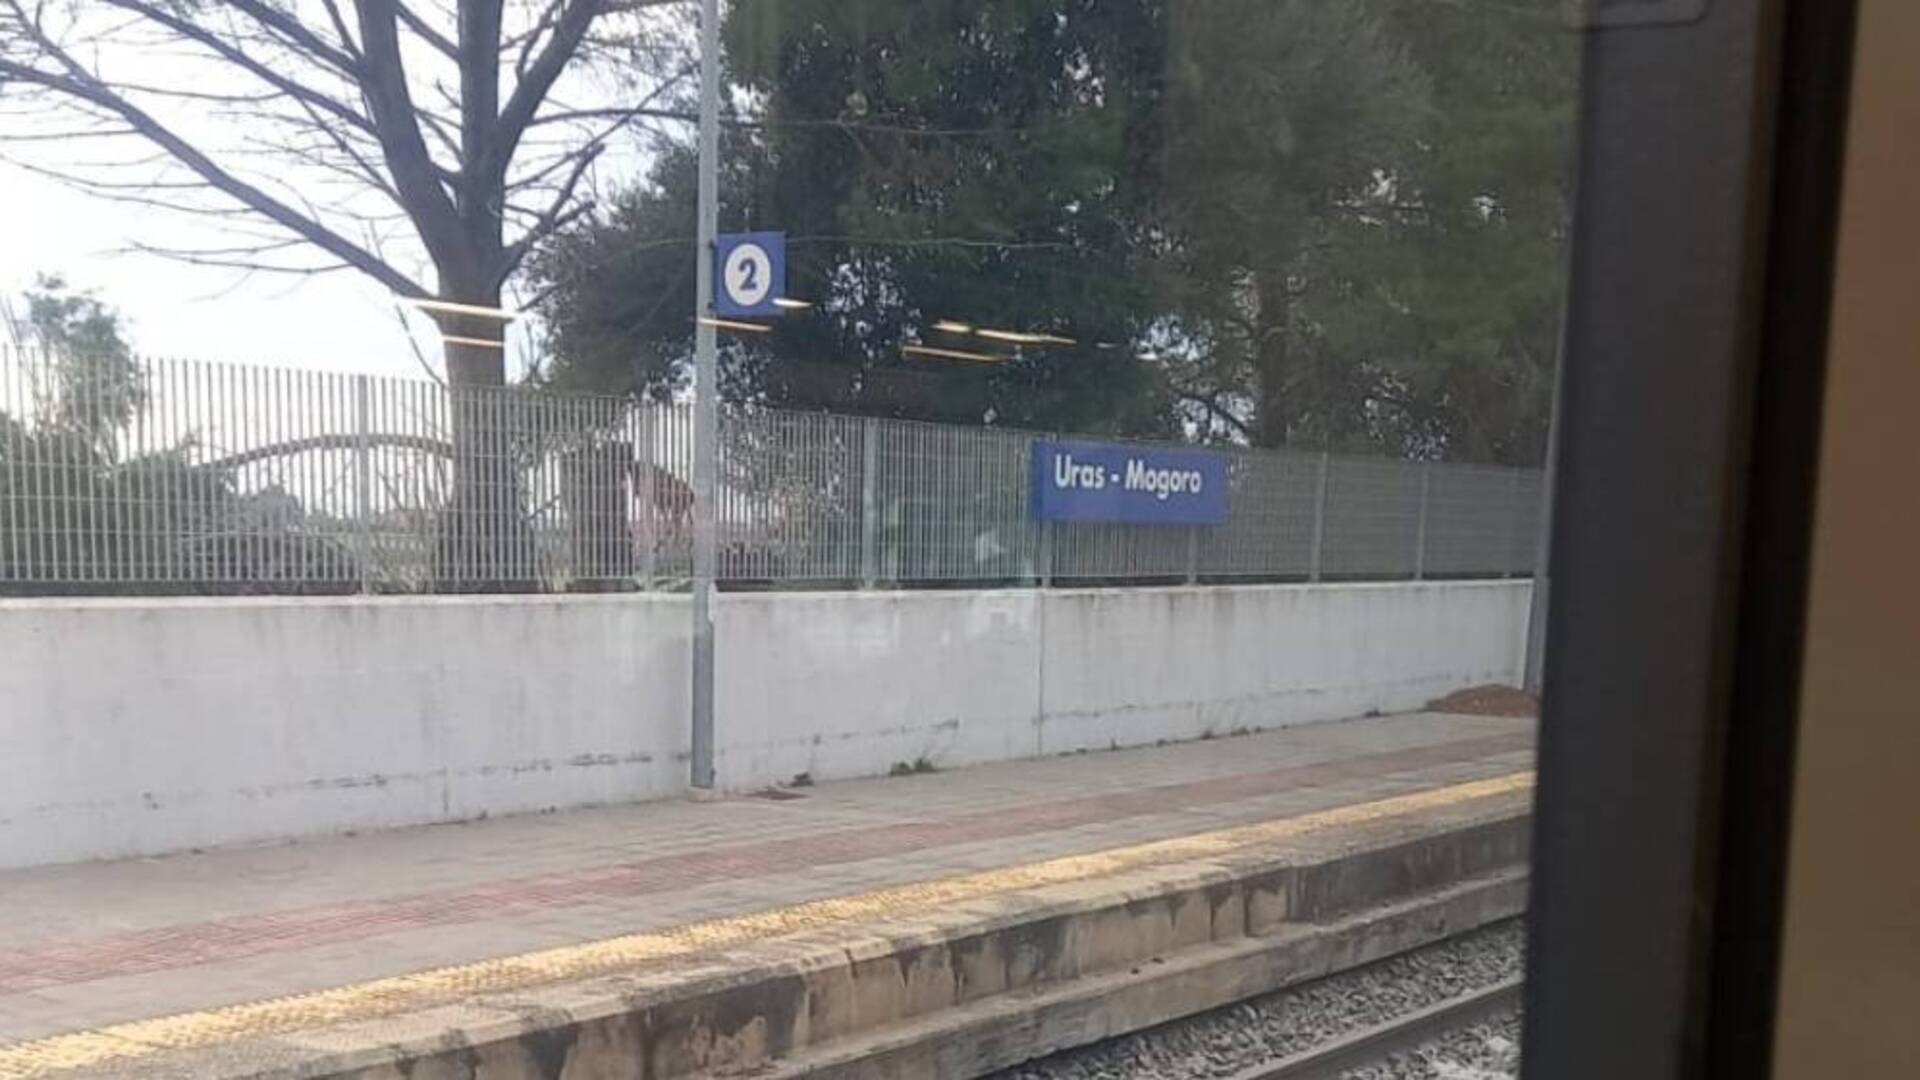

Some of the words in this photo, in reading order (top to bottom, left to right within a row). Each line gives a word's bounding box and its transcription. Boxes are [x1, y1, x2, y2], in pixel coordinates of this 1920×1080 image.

[738, 257, 758, 291] 2
[1055, 453, 1106, 489] Uras
[1125, 458, 1202, 500] Mogoro
